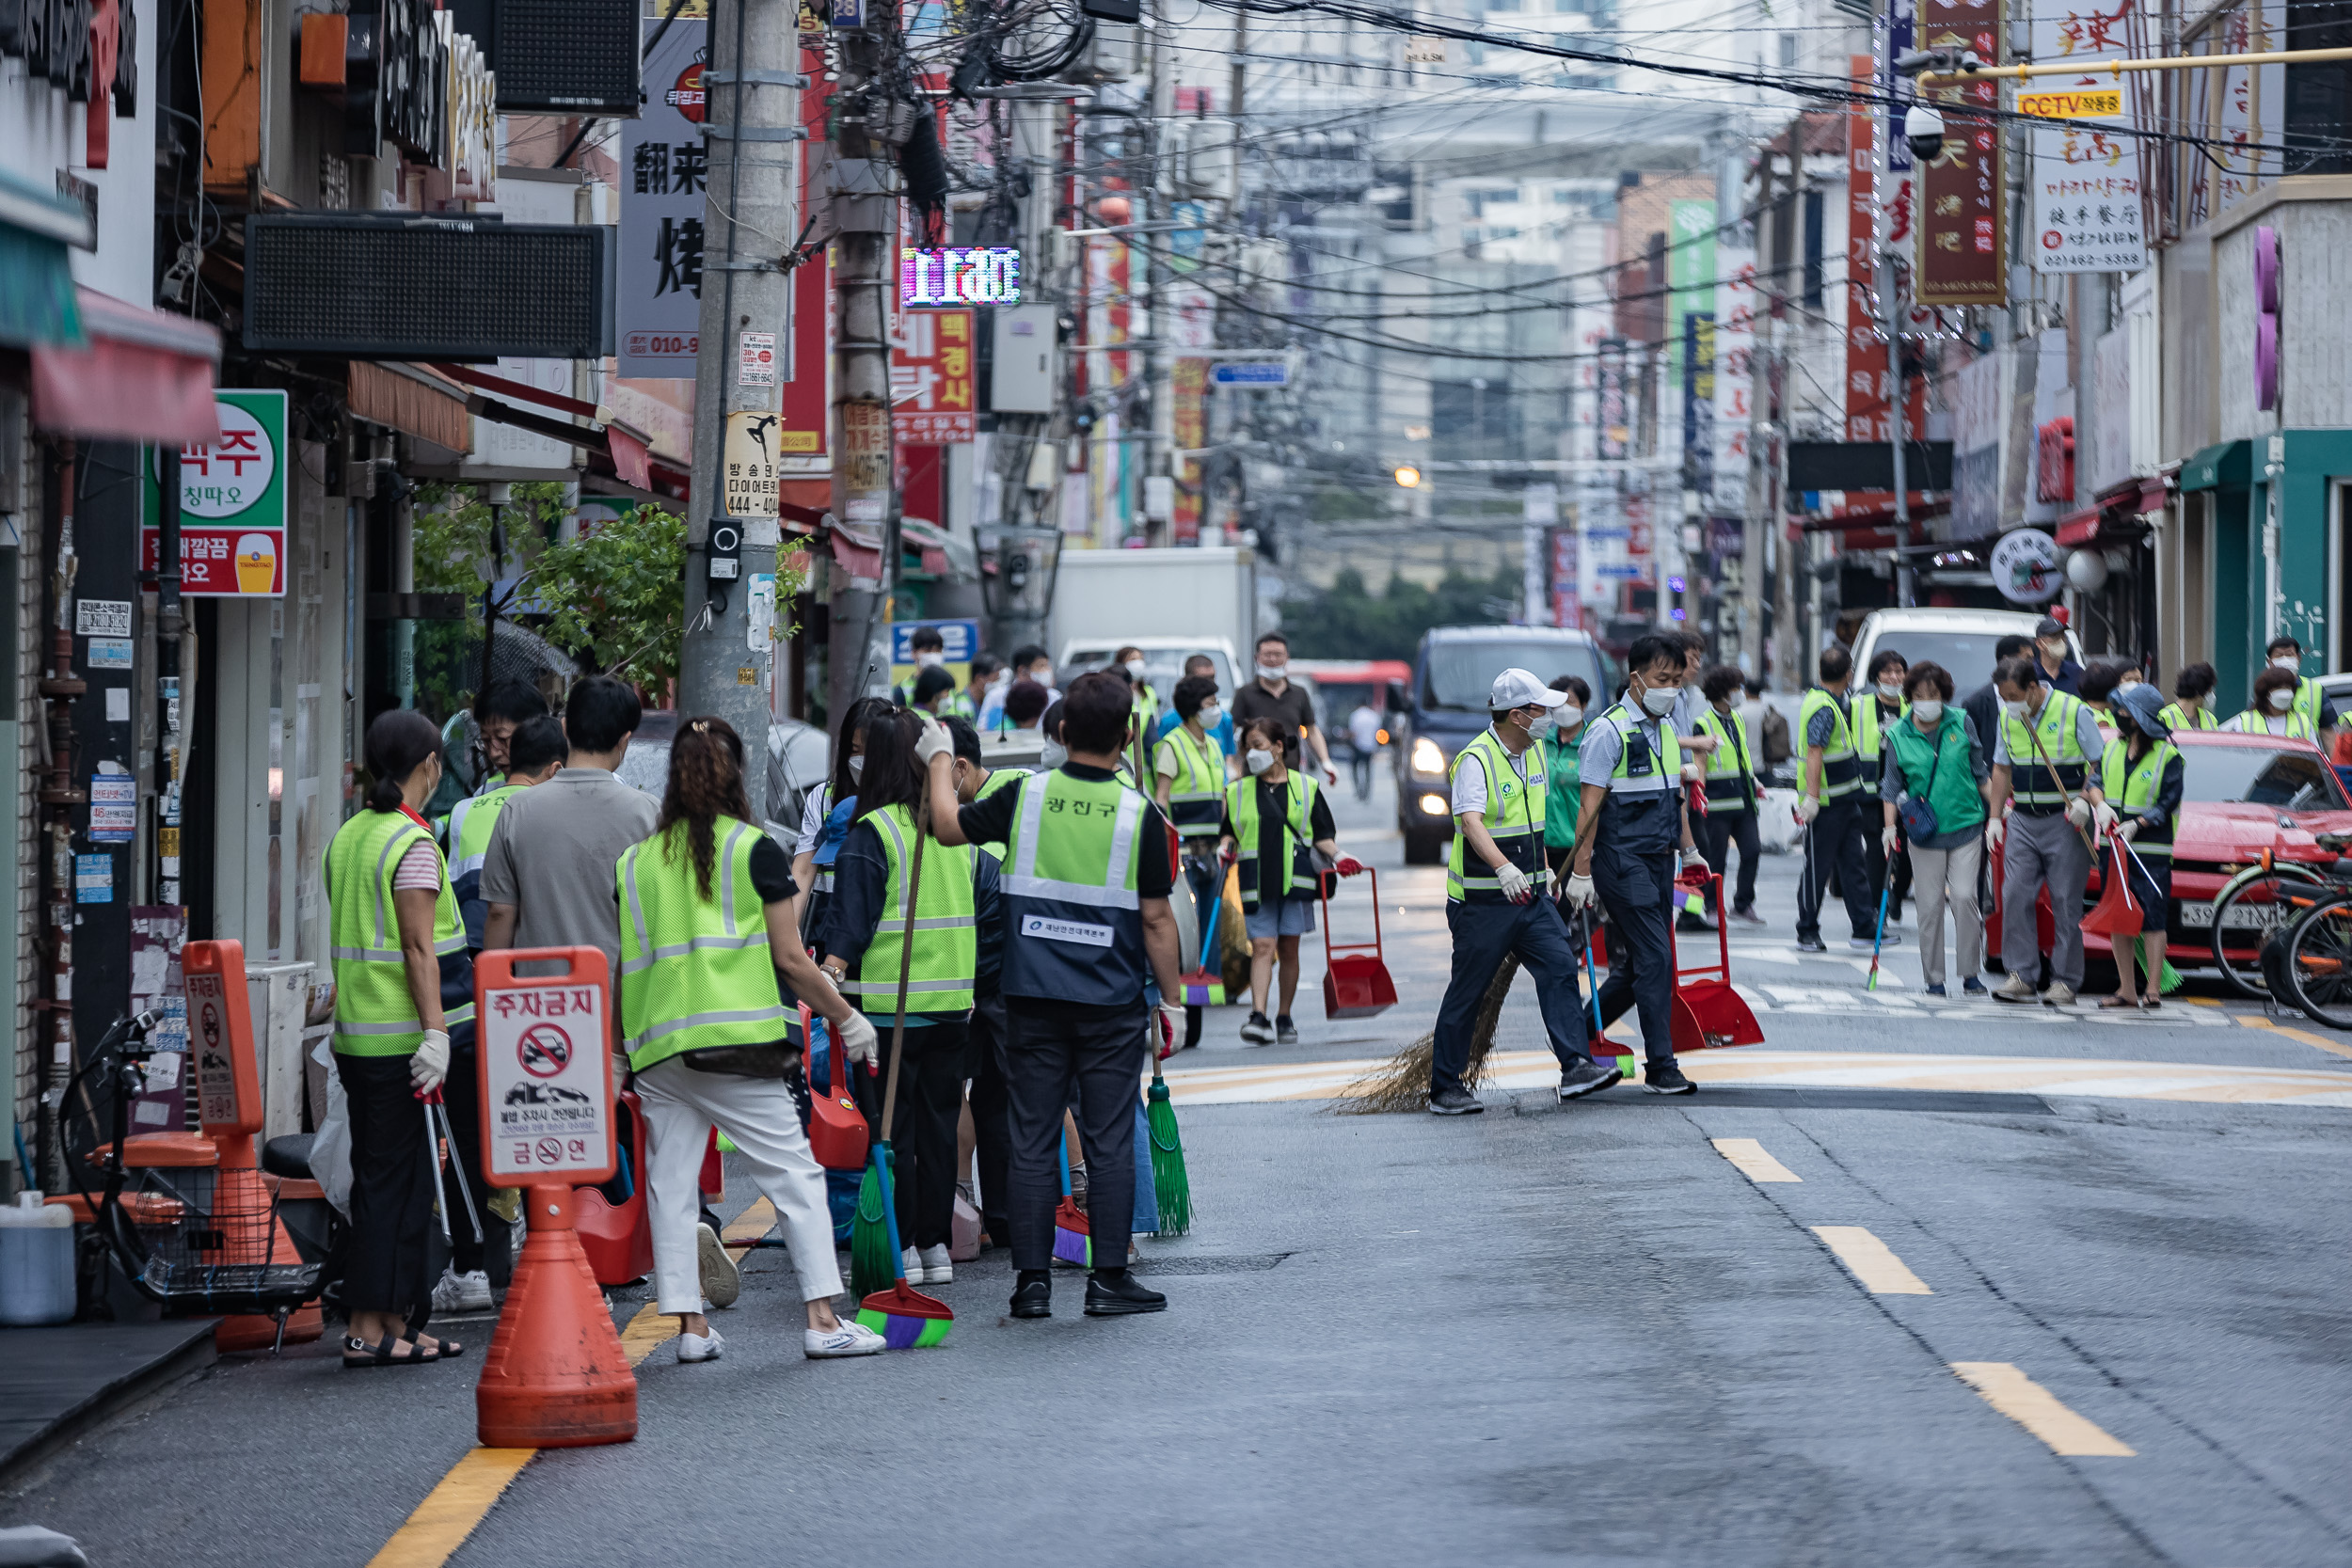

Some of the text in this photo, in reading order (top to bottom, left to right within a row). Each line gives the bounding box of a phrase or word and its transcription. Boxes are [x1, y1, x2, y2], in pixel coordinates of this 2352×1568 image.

[2023, 95, 2119, 115] CCTV 작동중
[183, 486, 244, 507] 칭따오
[1046, 797, 1116, 817] 광진구
[513, 1141, 531, 1164] 금
